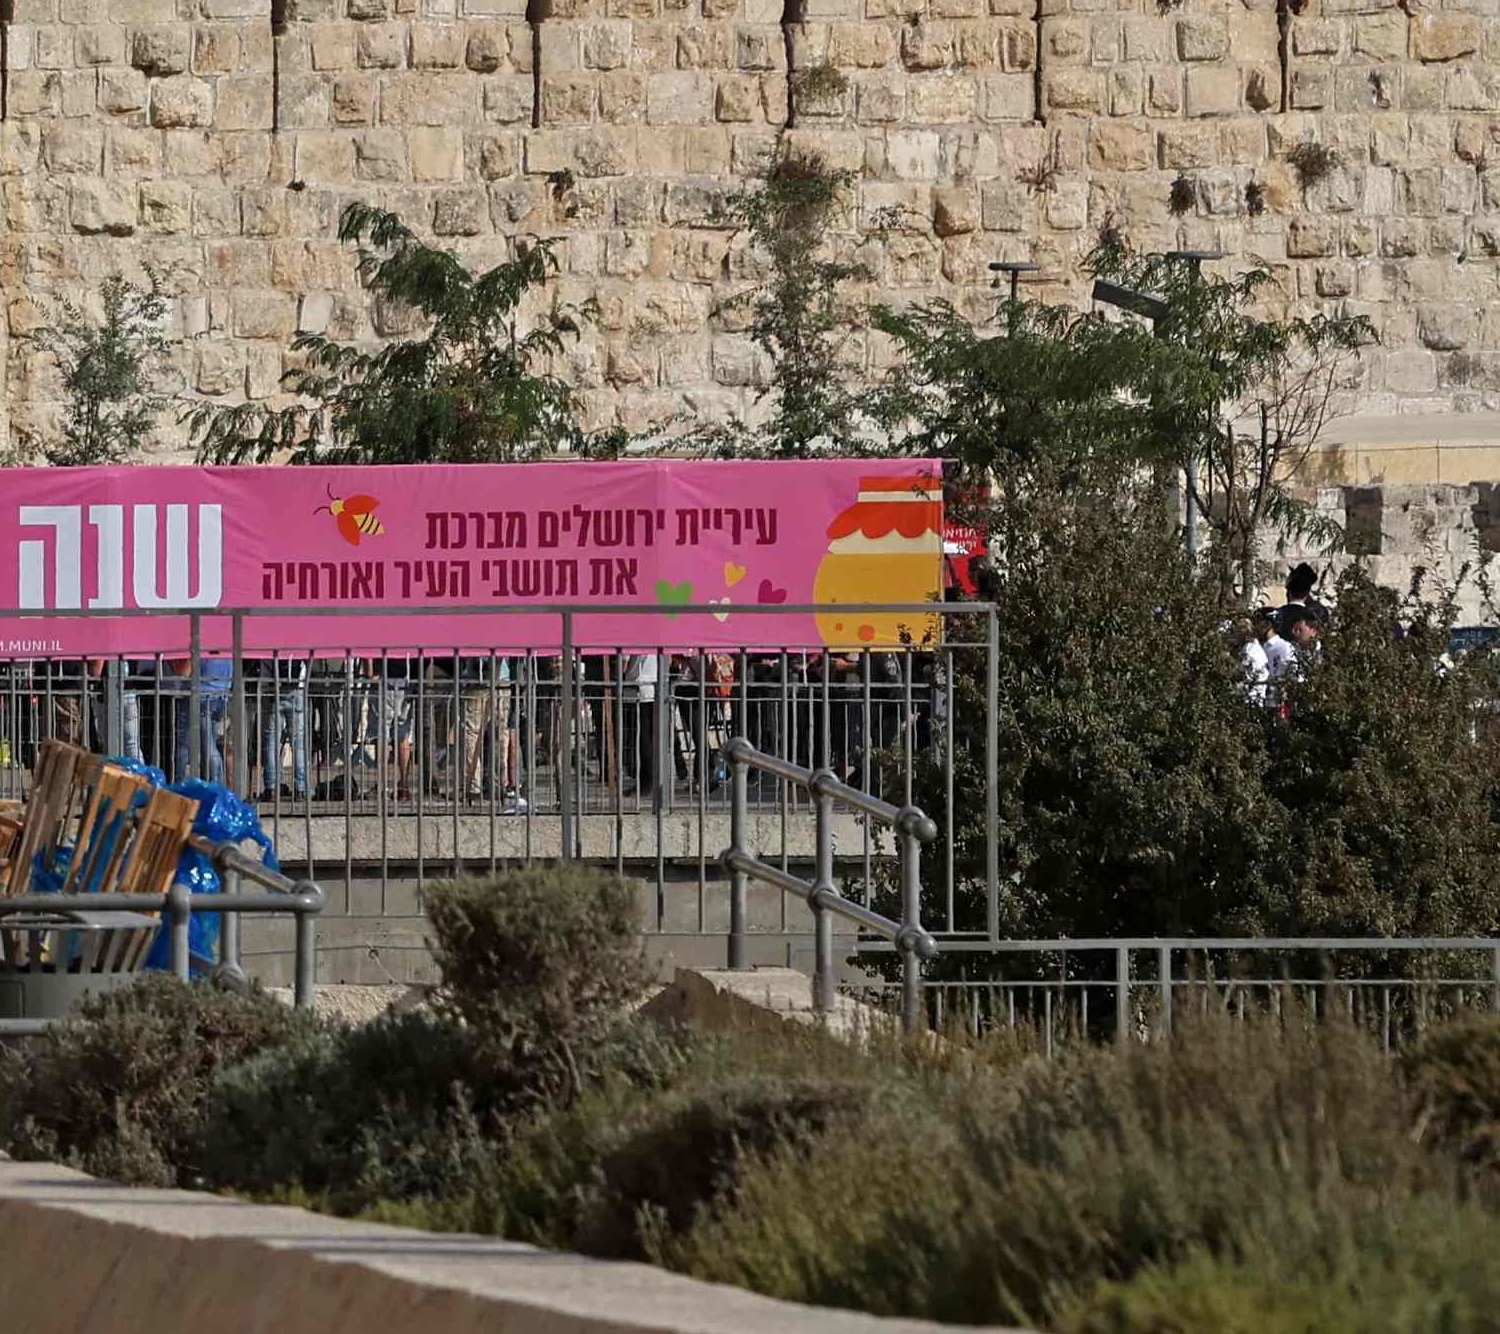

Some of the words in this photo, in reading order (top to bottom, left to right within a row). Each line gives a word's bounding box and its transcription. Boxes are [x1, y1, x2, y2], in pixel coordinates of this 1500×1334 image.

[424, 508, 527, 549] מברכת
[537, 503, 666, 548] ירושלים
[674, 507, 778, 547] עיריית
[18, 504, 223, 619] שנה
[260, 559, 385, 601] ואורחיה
[393, 558, 471, 599] העיר
[480, 556, 580, 597] תושבי
[588, 556, 639, 596] את
